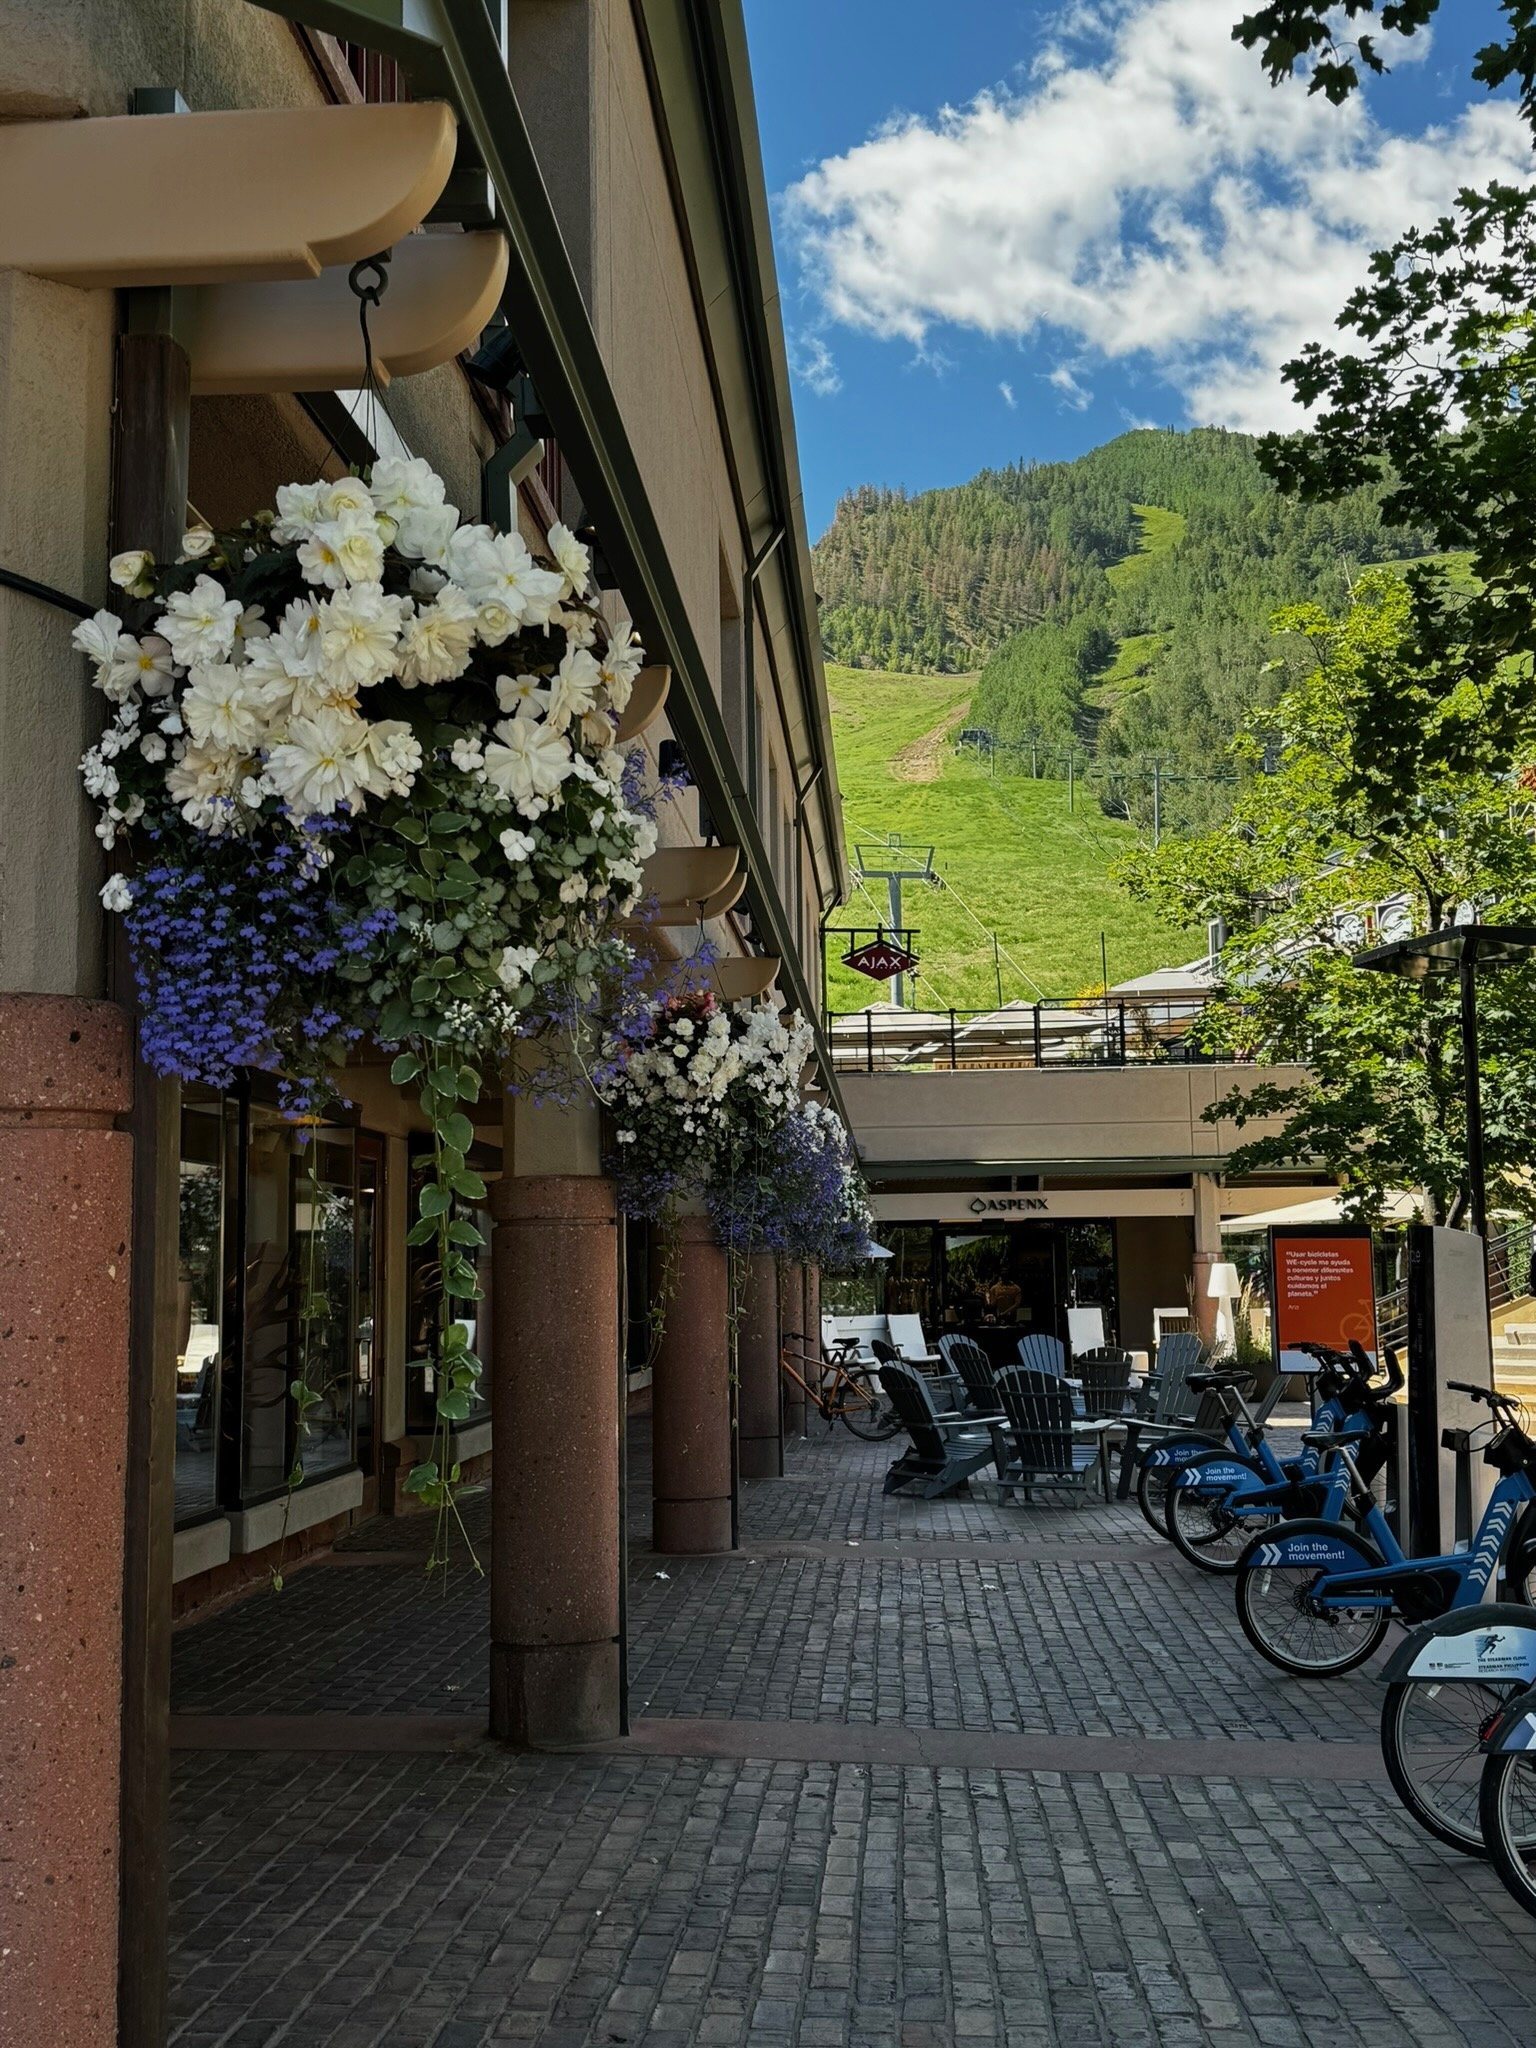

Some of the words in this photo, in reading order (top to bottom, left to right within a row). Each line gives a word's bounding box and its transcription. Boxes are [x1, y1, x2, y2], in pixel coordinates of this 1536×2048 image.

[858, 956, 901, 969] AJAX
[988, 1198, 1048, 1210] ASPENX
[1206, 1473, 1246, 1481] movement!
[1288, 1543, 1309, 1552] Join
[1312, 1543, 1328, 1552] the
[1289, 1550, 1345, 1560] movement!
